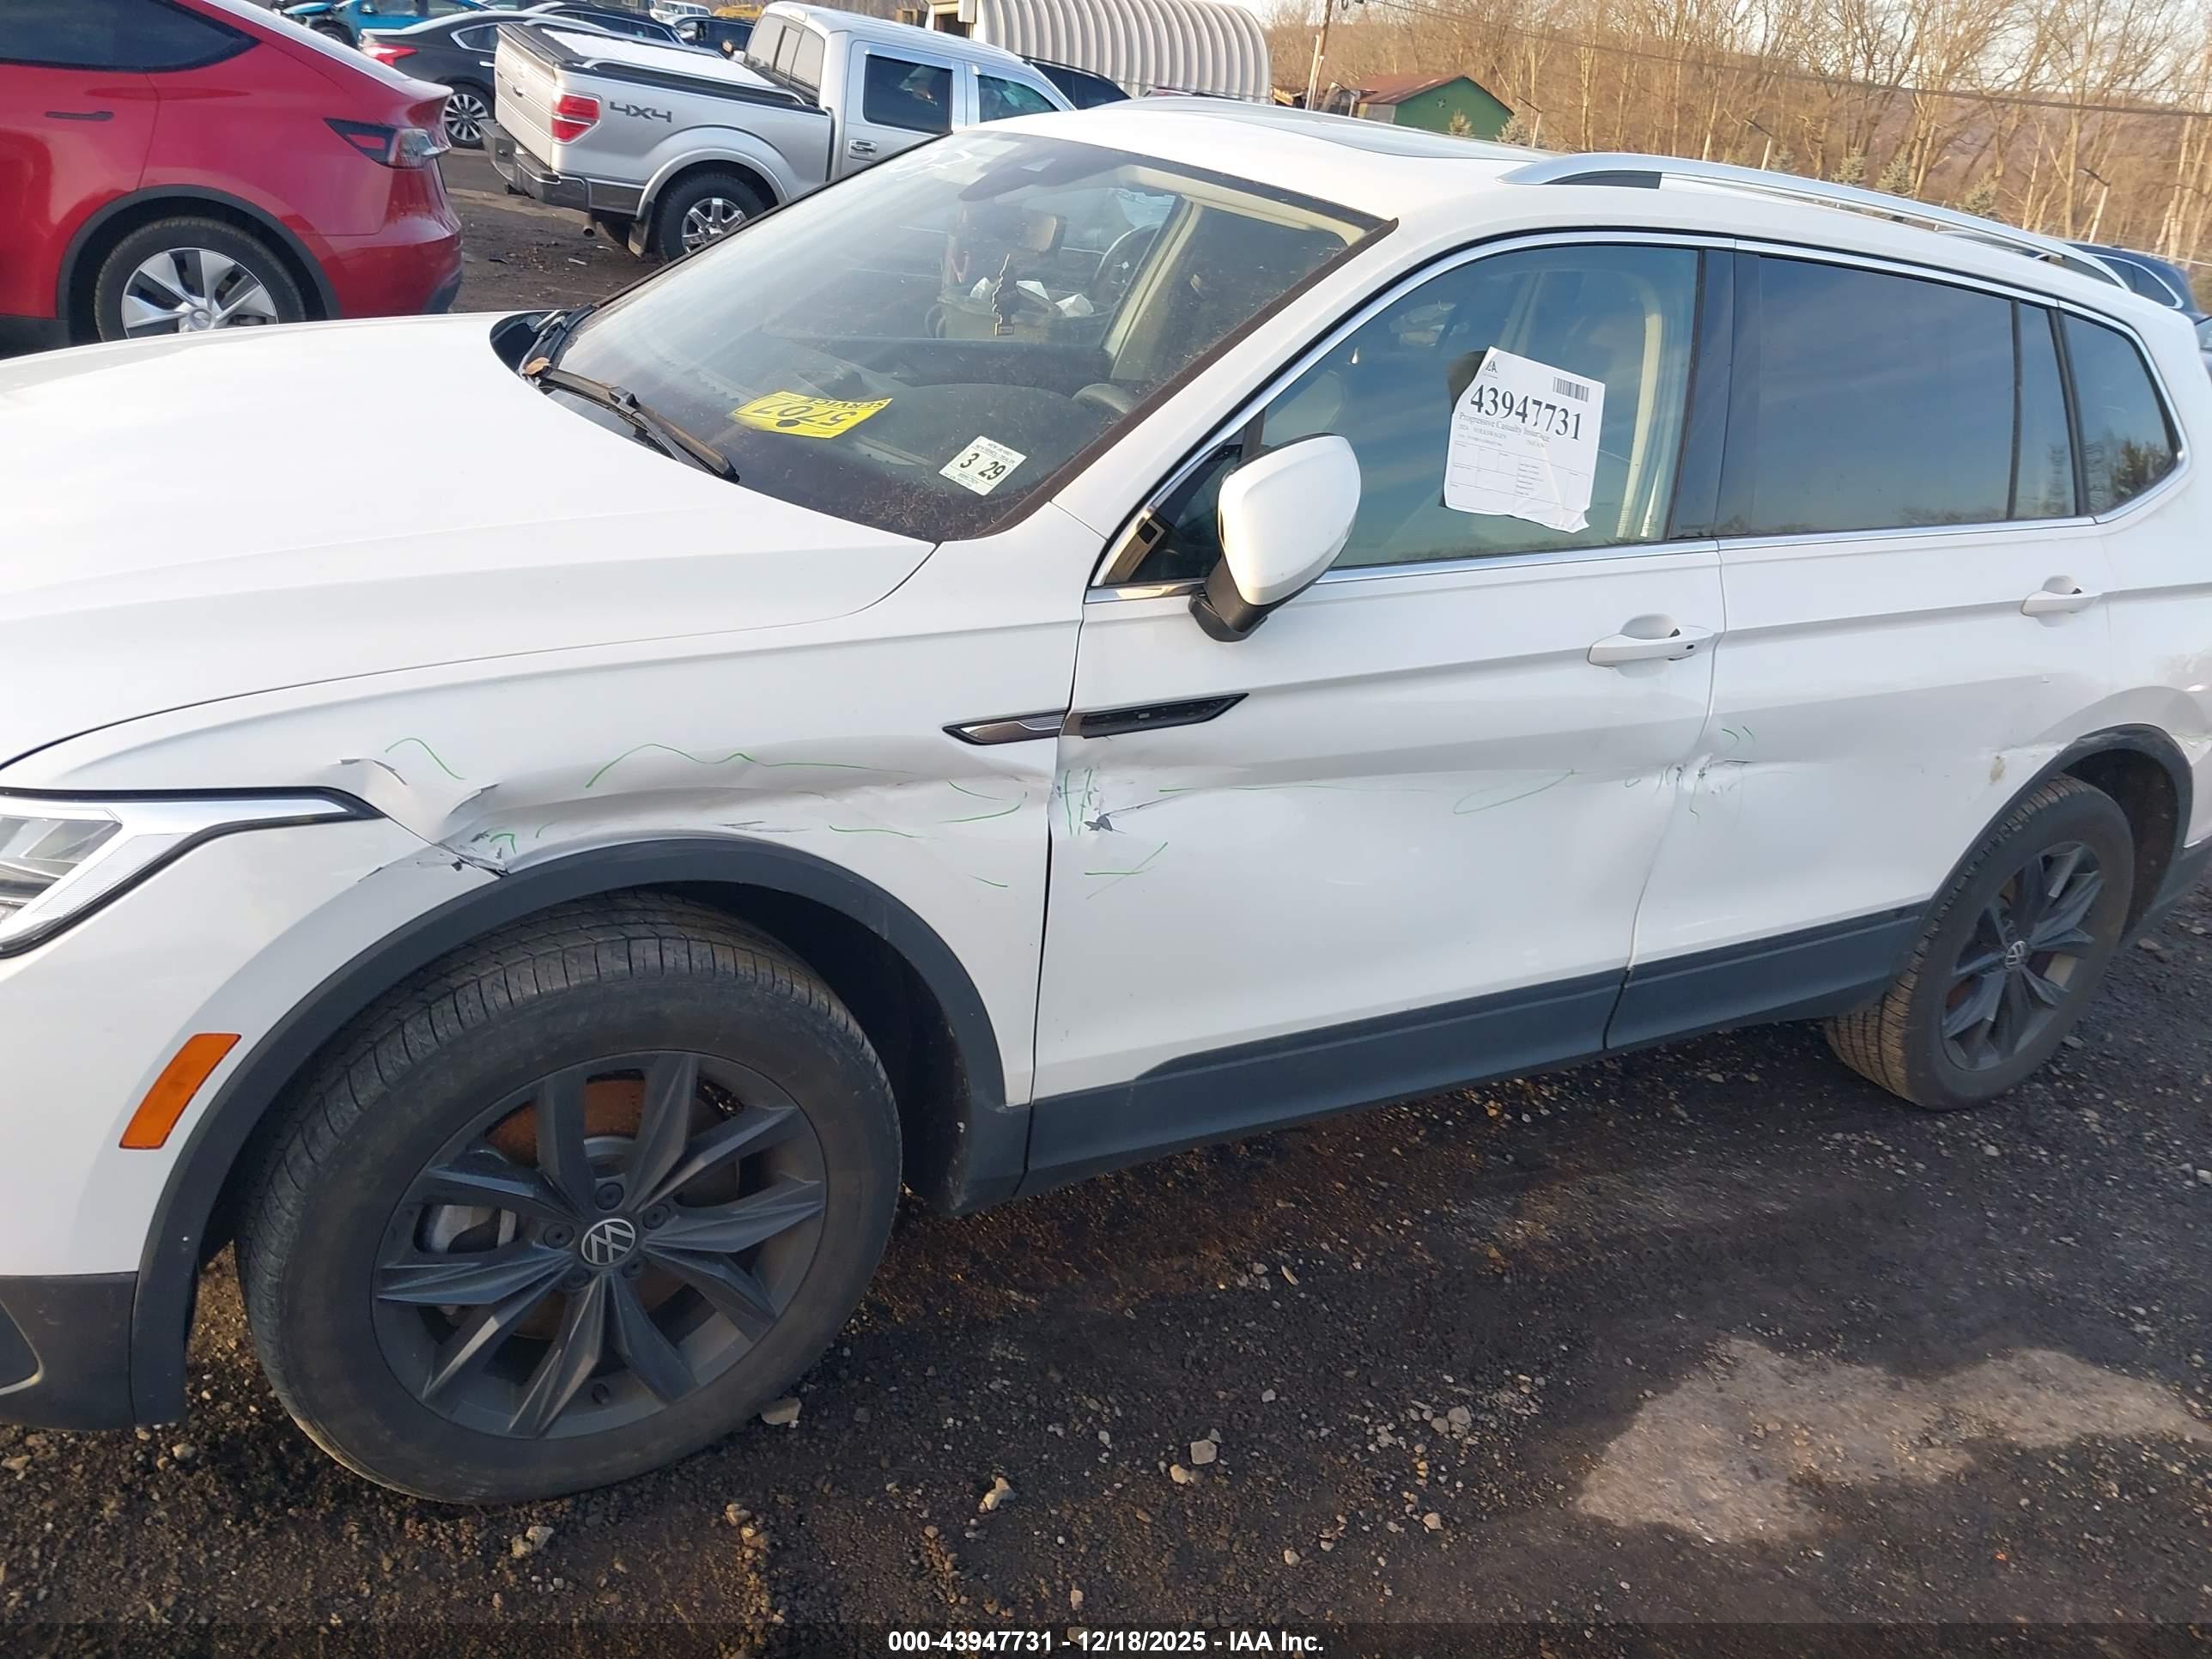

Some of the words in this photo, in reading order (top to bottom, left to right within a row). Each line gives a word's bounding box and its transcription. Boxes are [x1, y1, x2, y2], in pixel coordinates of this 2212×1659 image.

[609, 101, 672, 123] 4X4
[750, 402, 858, 427] 5707
[803, 398, 887, 409] SERVICE
[1470, 384, 1581, 441] 43947731
[959, 453, 981, 469] 3
[977, 460, 1006, 481] 29
